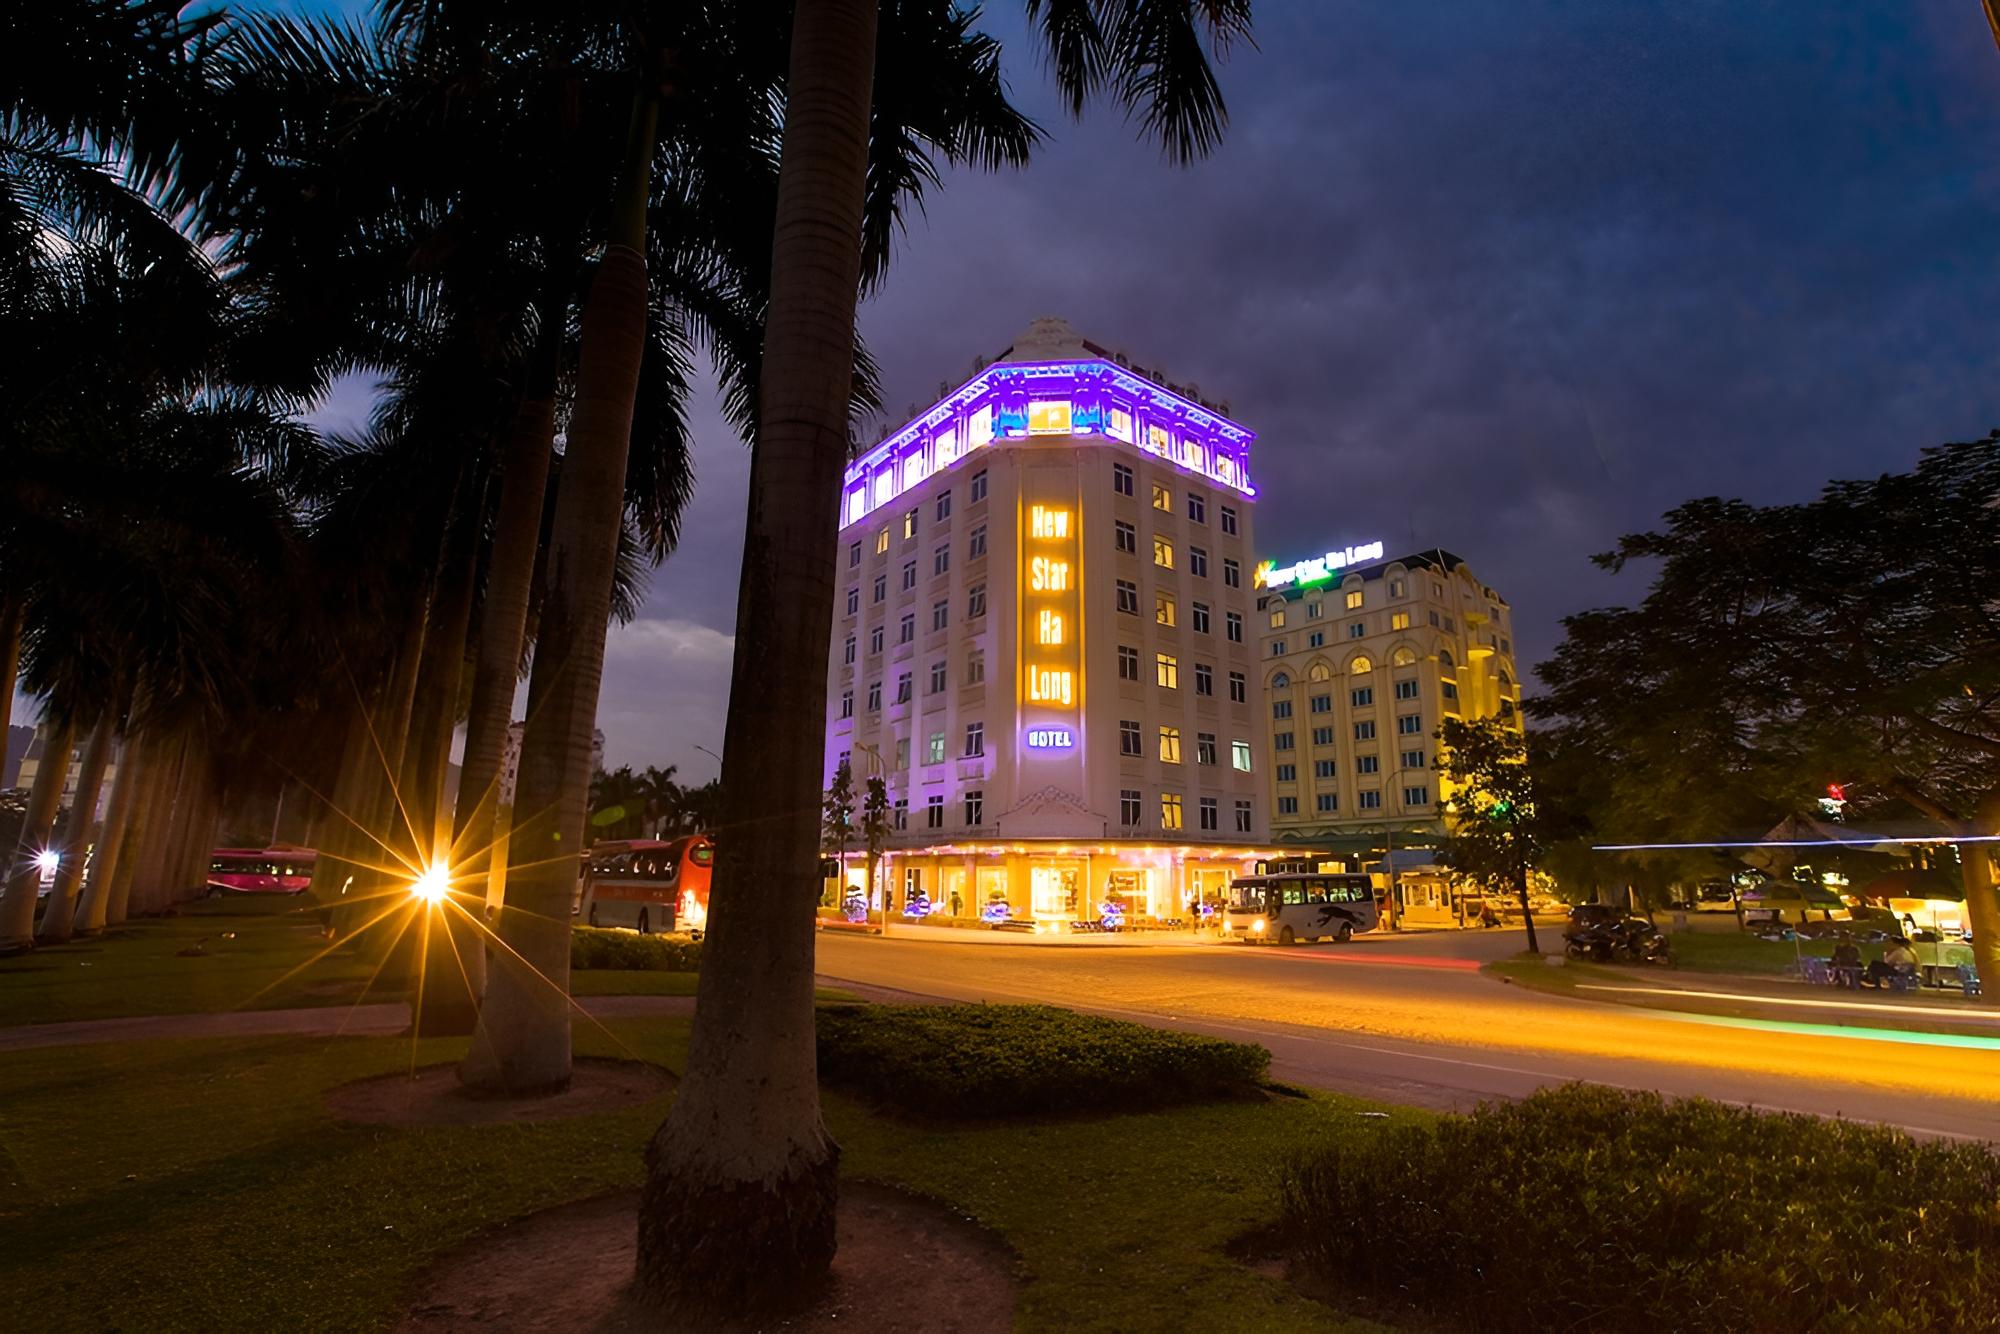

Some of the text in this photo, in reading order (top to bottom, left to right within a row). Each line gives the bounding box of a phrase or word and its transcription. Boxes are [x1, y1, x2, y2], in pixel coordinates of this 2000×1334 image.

[1032, 506, 1068, 538] New
[1032, 556, 1068, 591] Star
[1040, 610, 1062, 645] Ha
[1031, 664, 1071, 705] Long
[1029, 731, 1072, 747] HOTEL
